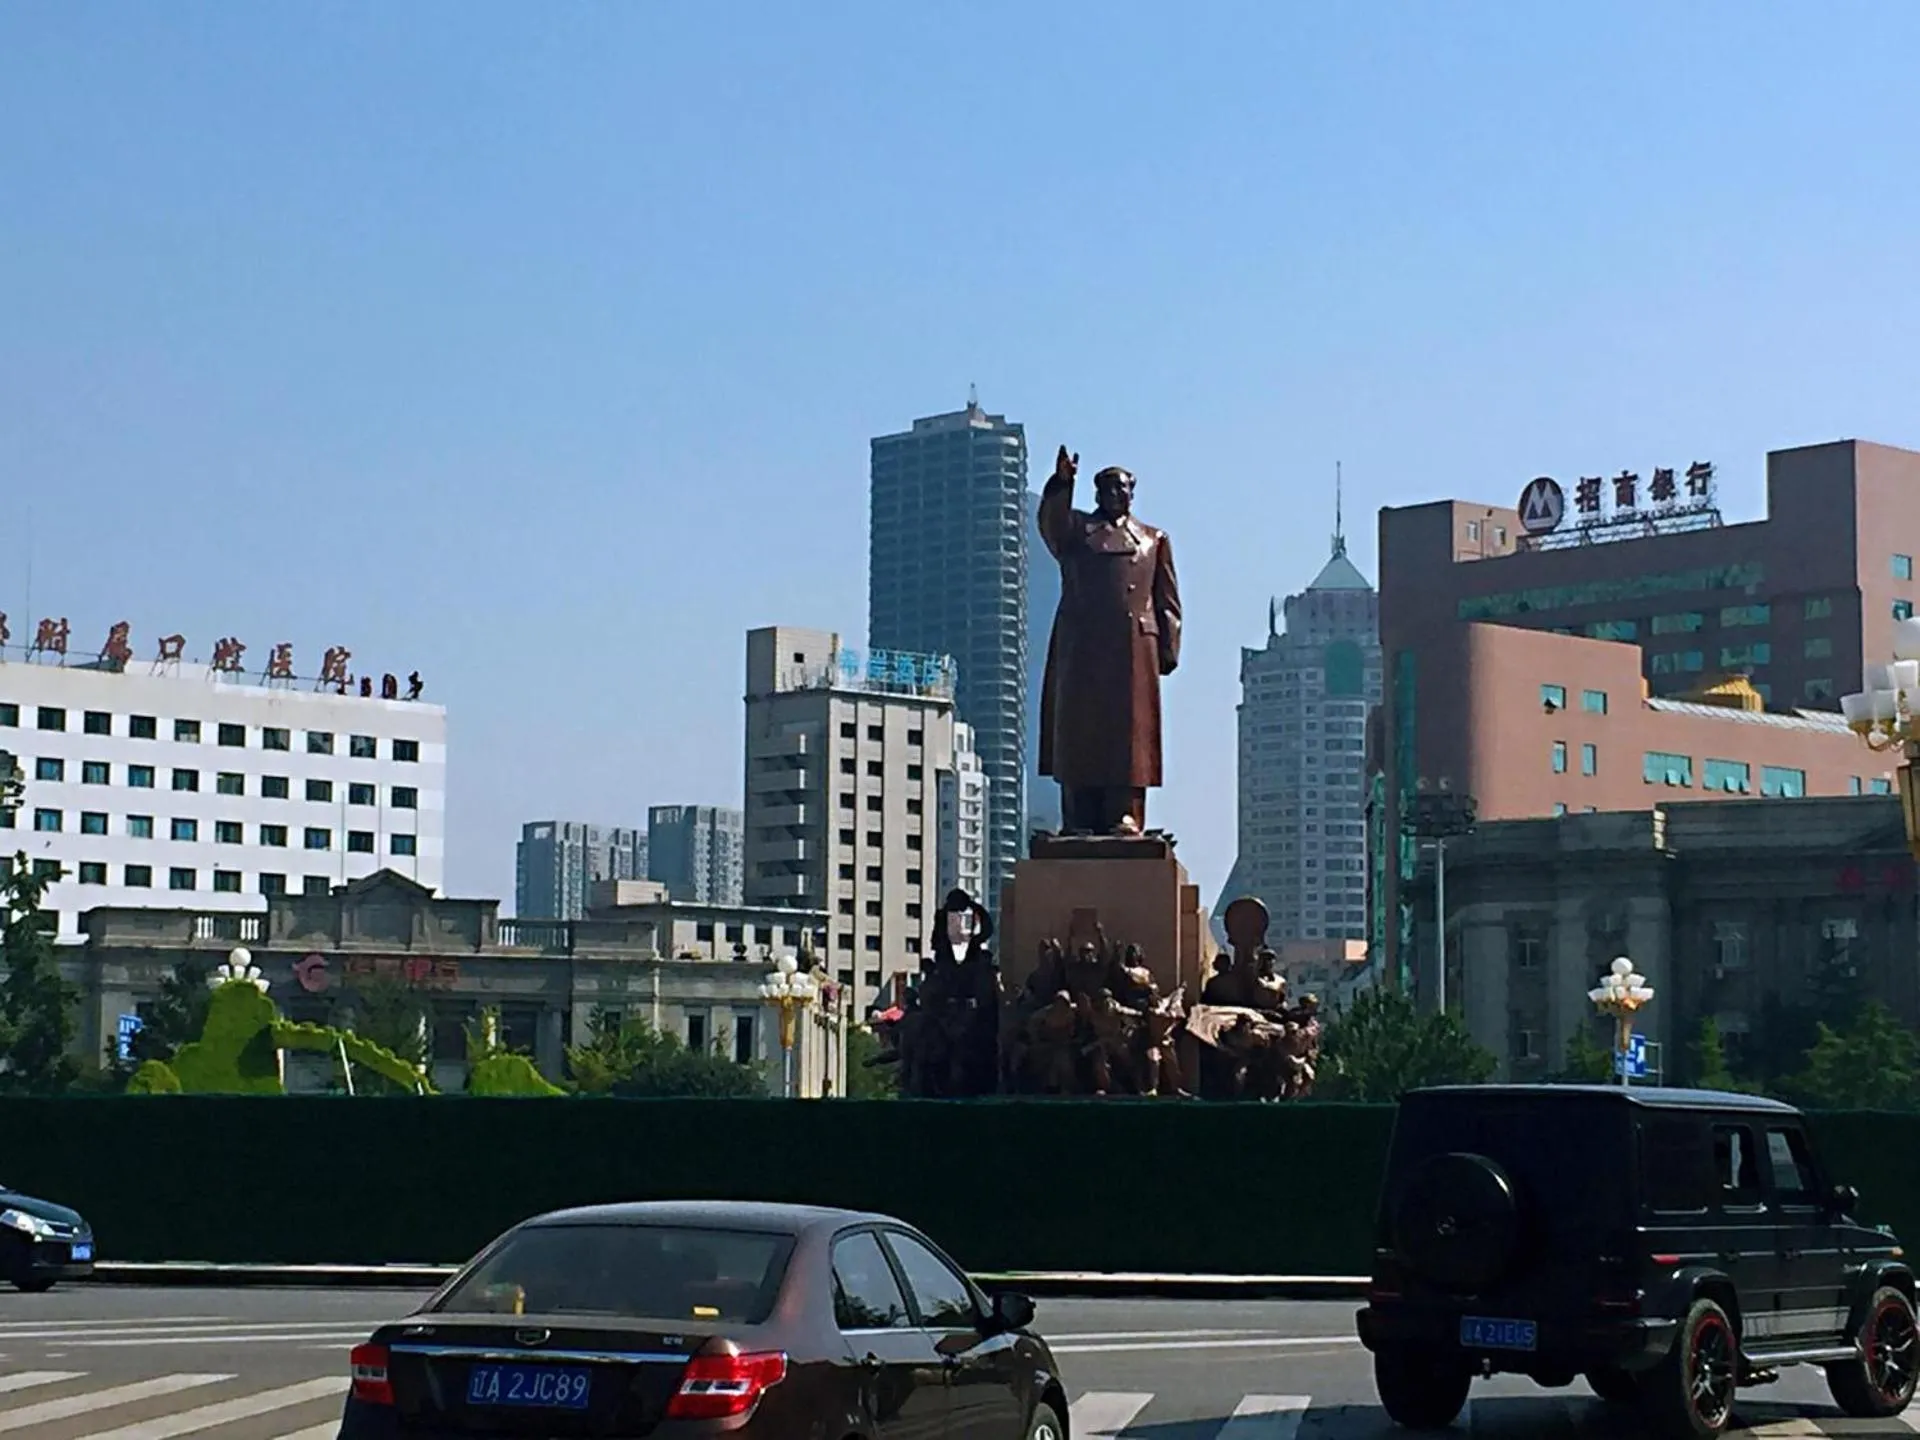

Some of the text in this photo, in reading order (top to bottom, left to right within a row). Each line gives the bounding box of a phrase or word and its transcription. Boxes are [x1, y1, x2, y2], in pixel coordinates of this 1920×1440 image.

[1575, 461, 1713, 513] 招商银行
[0, 611, 351, 683] 附属口腔医院
